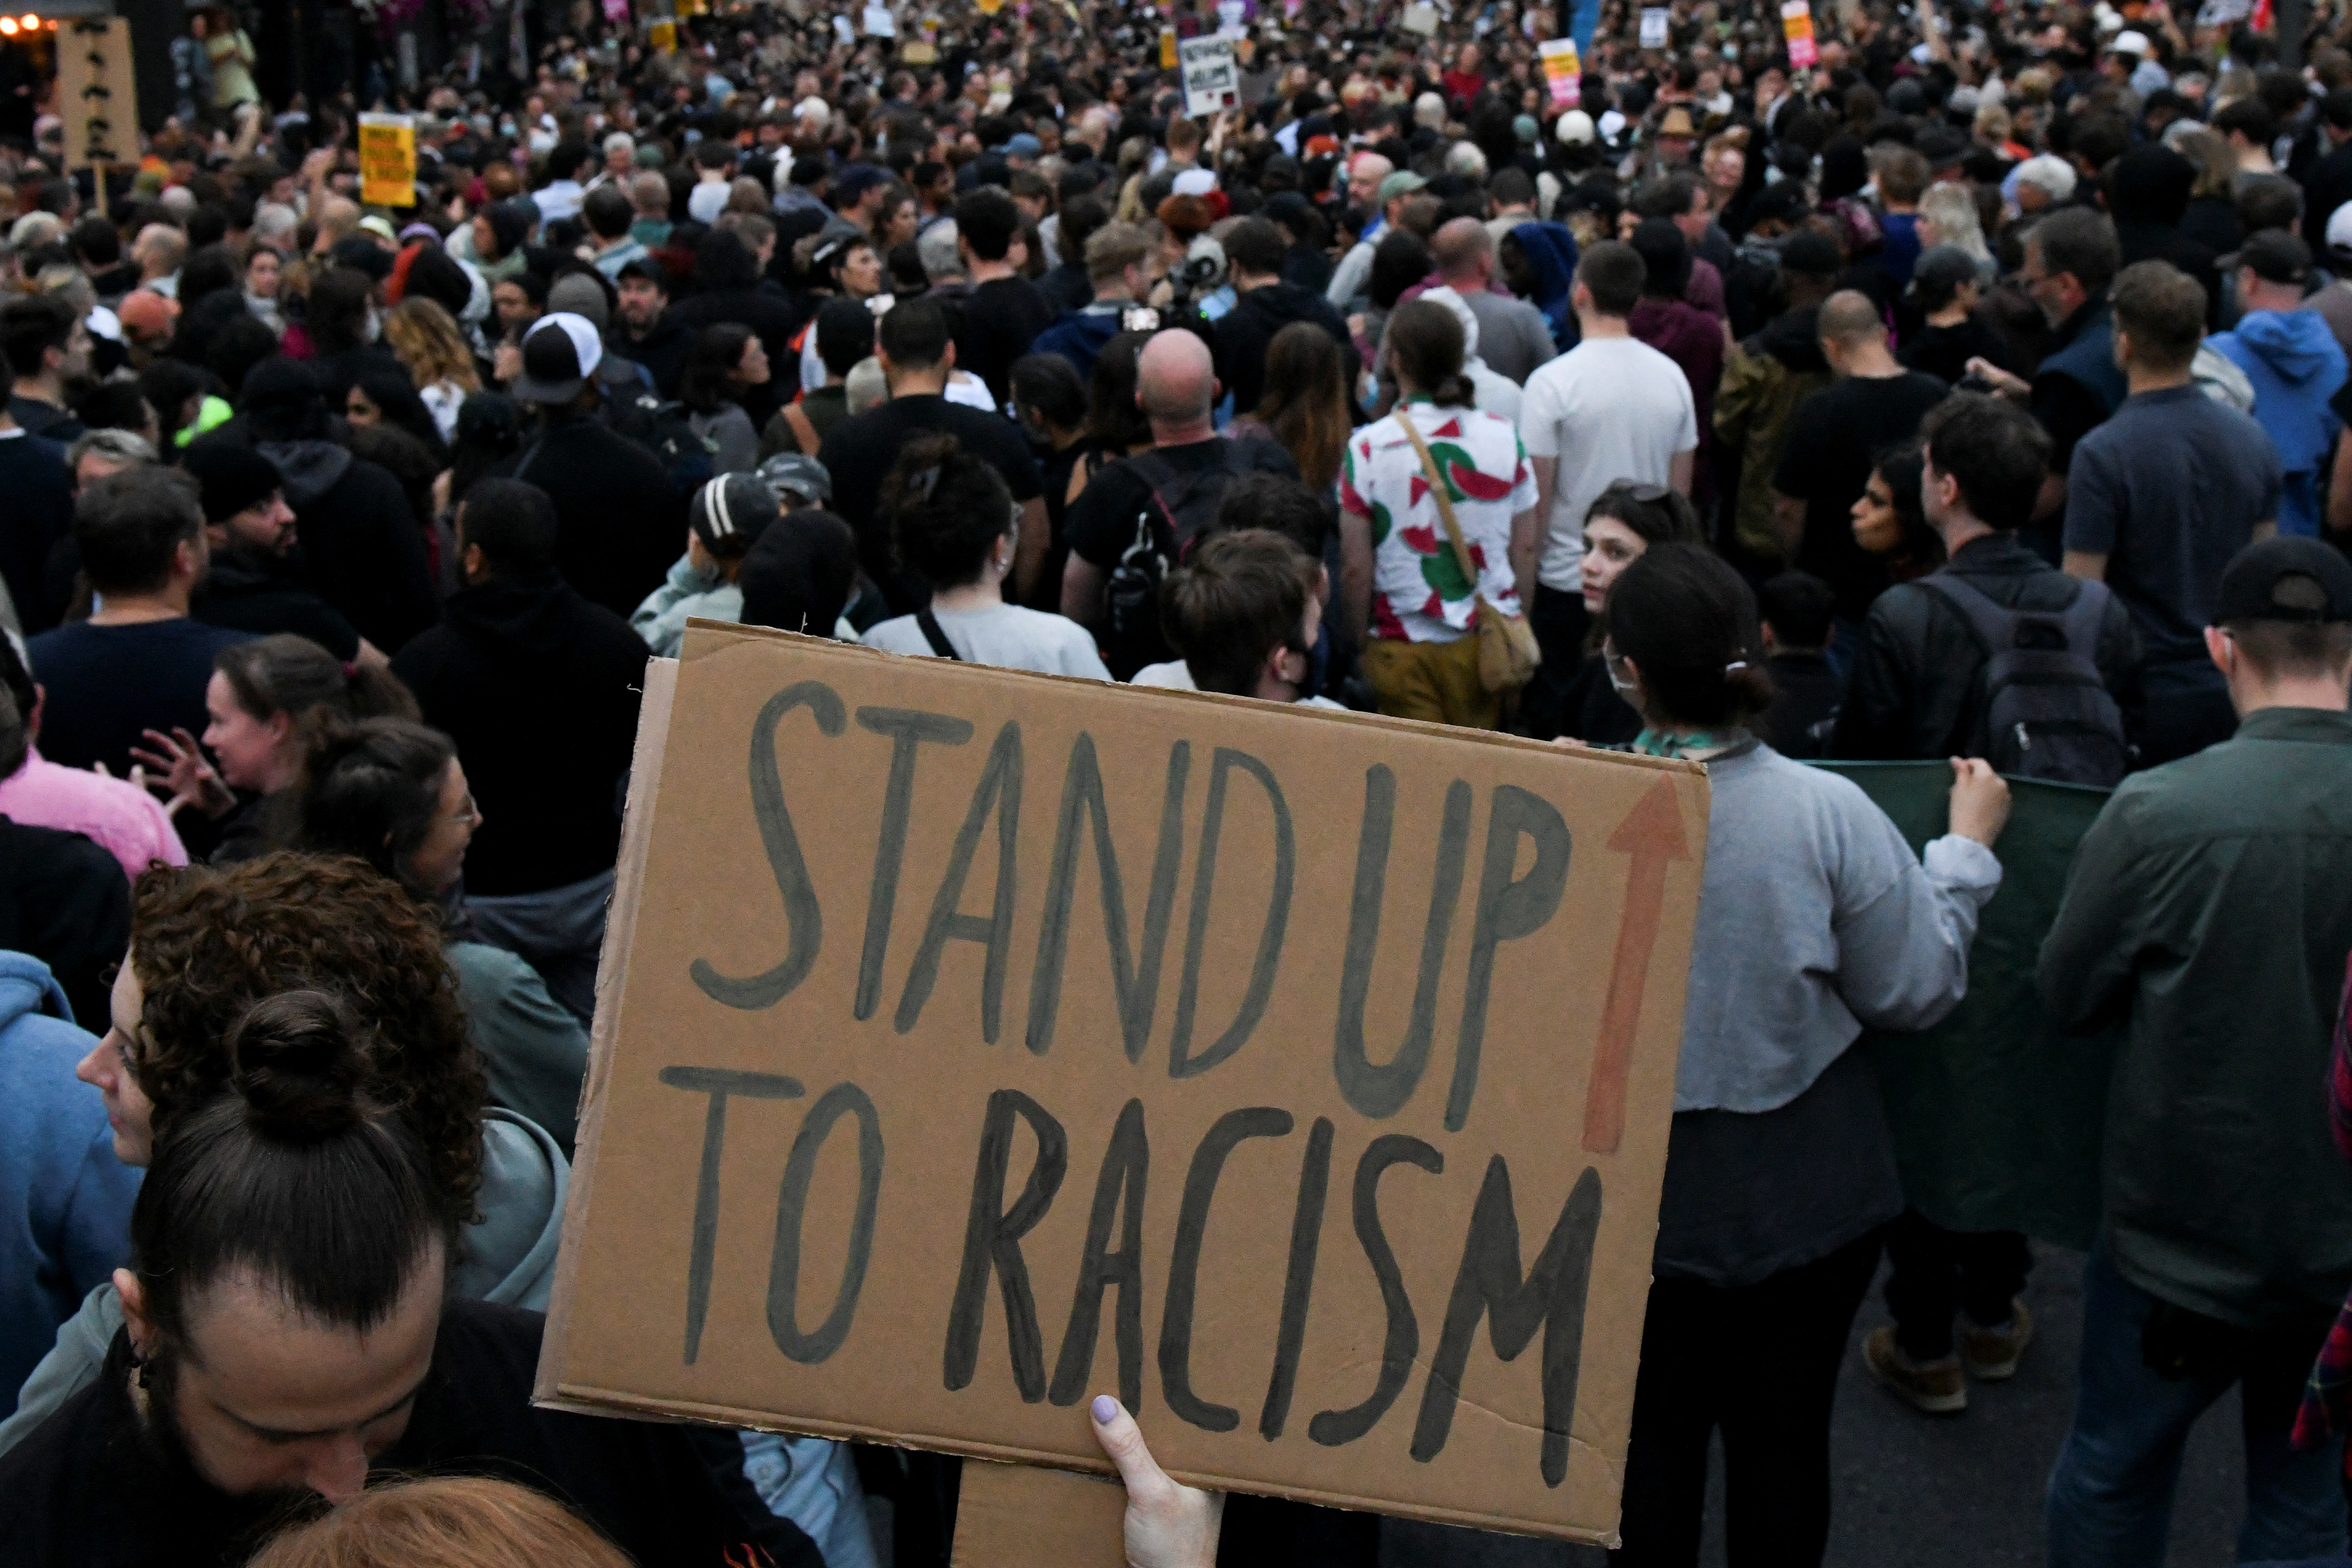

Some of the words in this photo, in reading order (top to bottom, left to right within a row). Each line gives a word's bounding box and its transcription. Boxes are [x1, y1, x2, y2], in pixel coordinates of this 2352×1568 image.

[689, 682, 1296, 1079] STAND
[1333, 763, 1572, 1133] UP
[658, 1065, 885, 1367] TO
[942, 1088, 1603, 1489] RACISM
